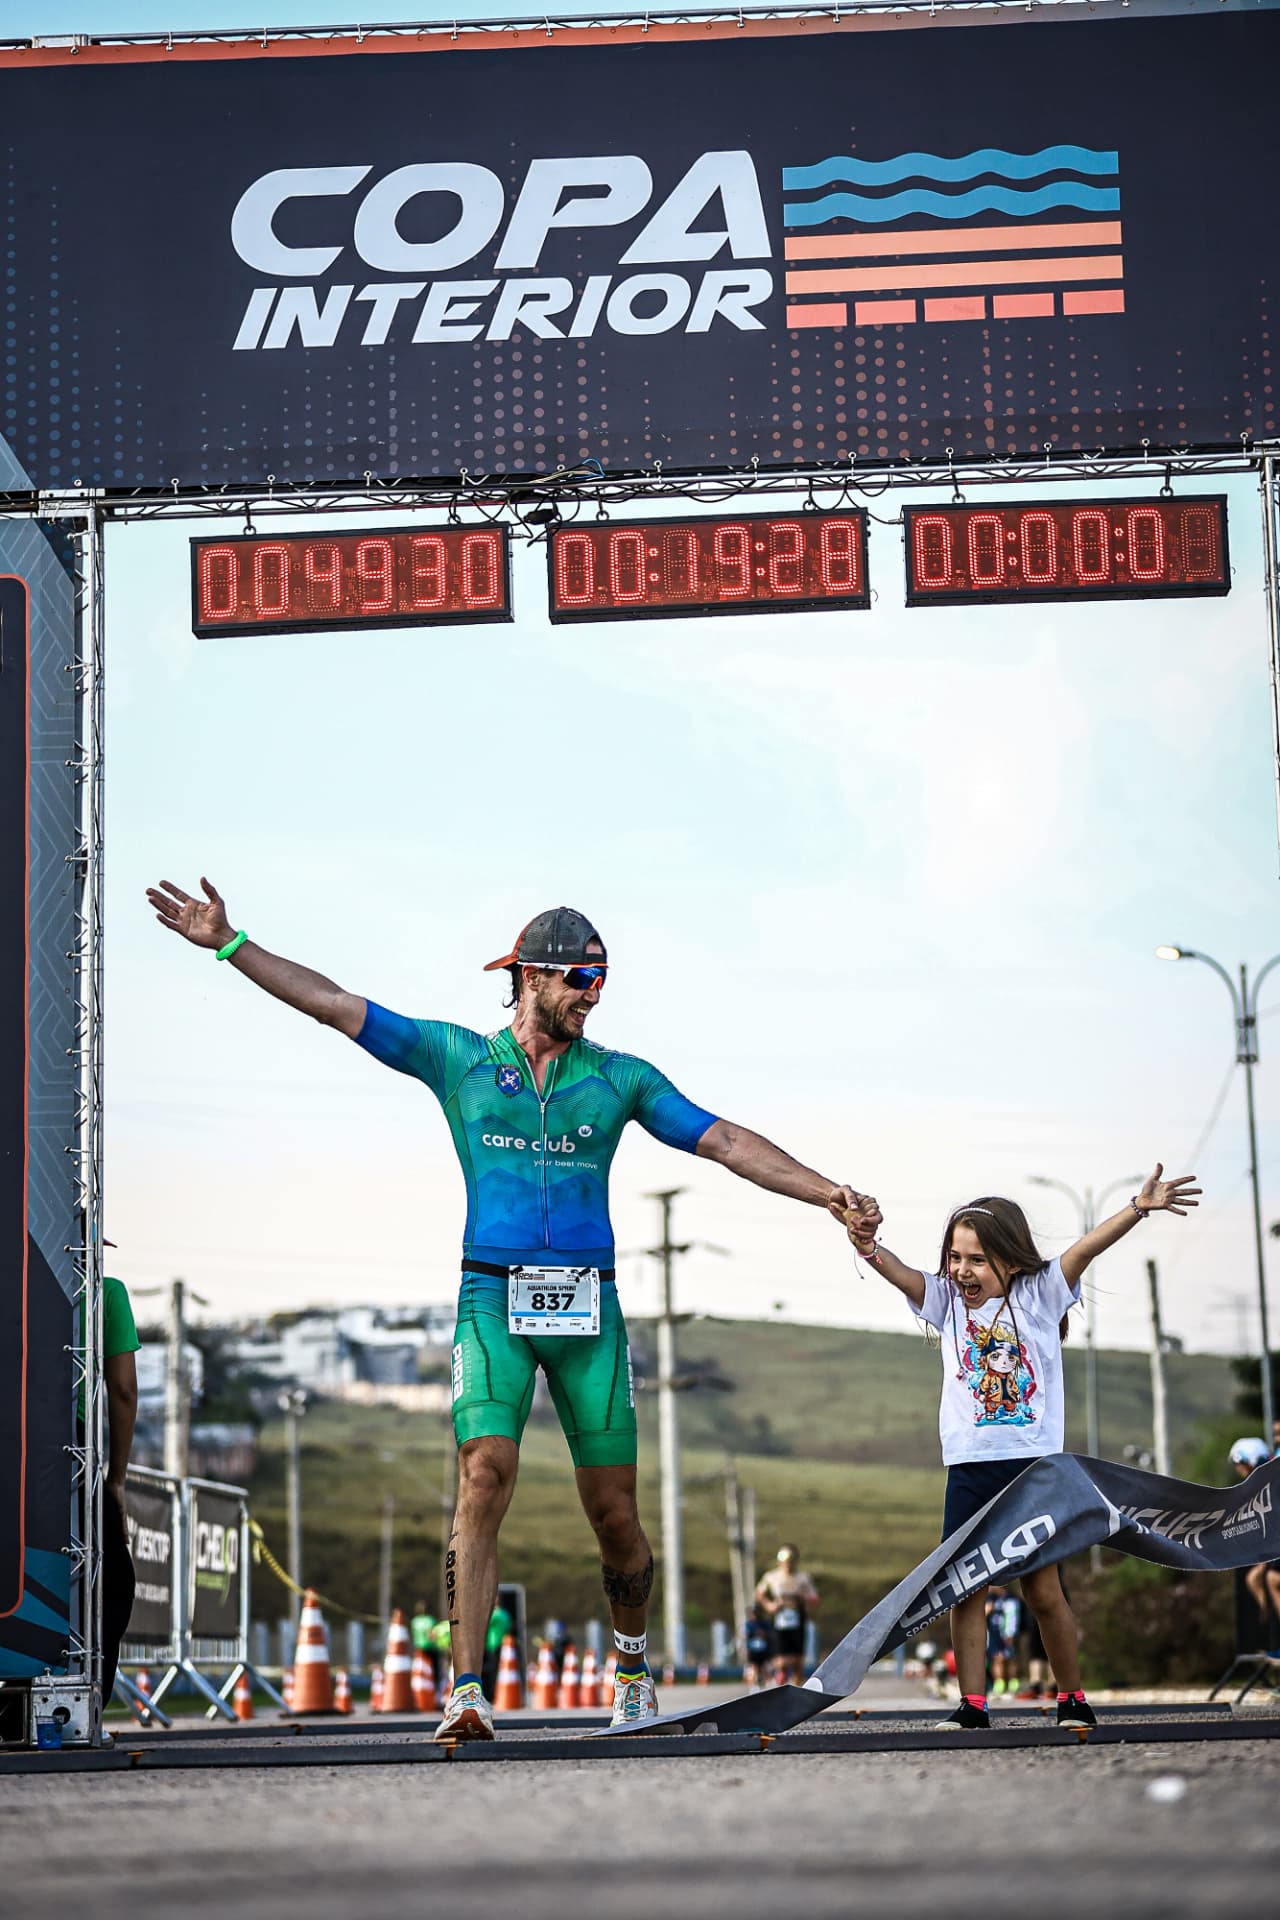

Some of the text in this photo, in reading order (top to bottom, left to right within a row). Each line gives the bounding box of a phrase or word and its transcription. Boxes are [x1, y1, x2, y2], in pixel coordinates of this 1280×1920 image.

[230, 149, 772, 277] COPA
[231, 268, 774, 351] INTERIOR
[555, 519, 858, 606] 00:19:28
[482, 1132, 576, 1153] care club
[533, 1159, 598, 1170] your best move
[531, 1292, 576, 1311] 837
[623, 1639, 646, 1651] 837
